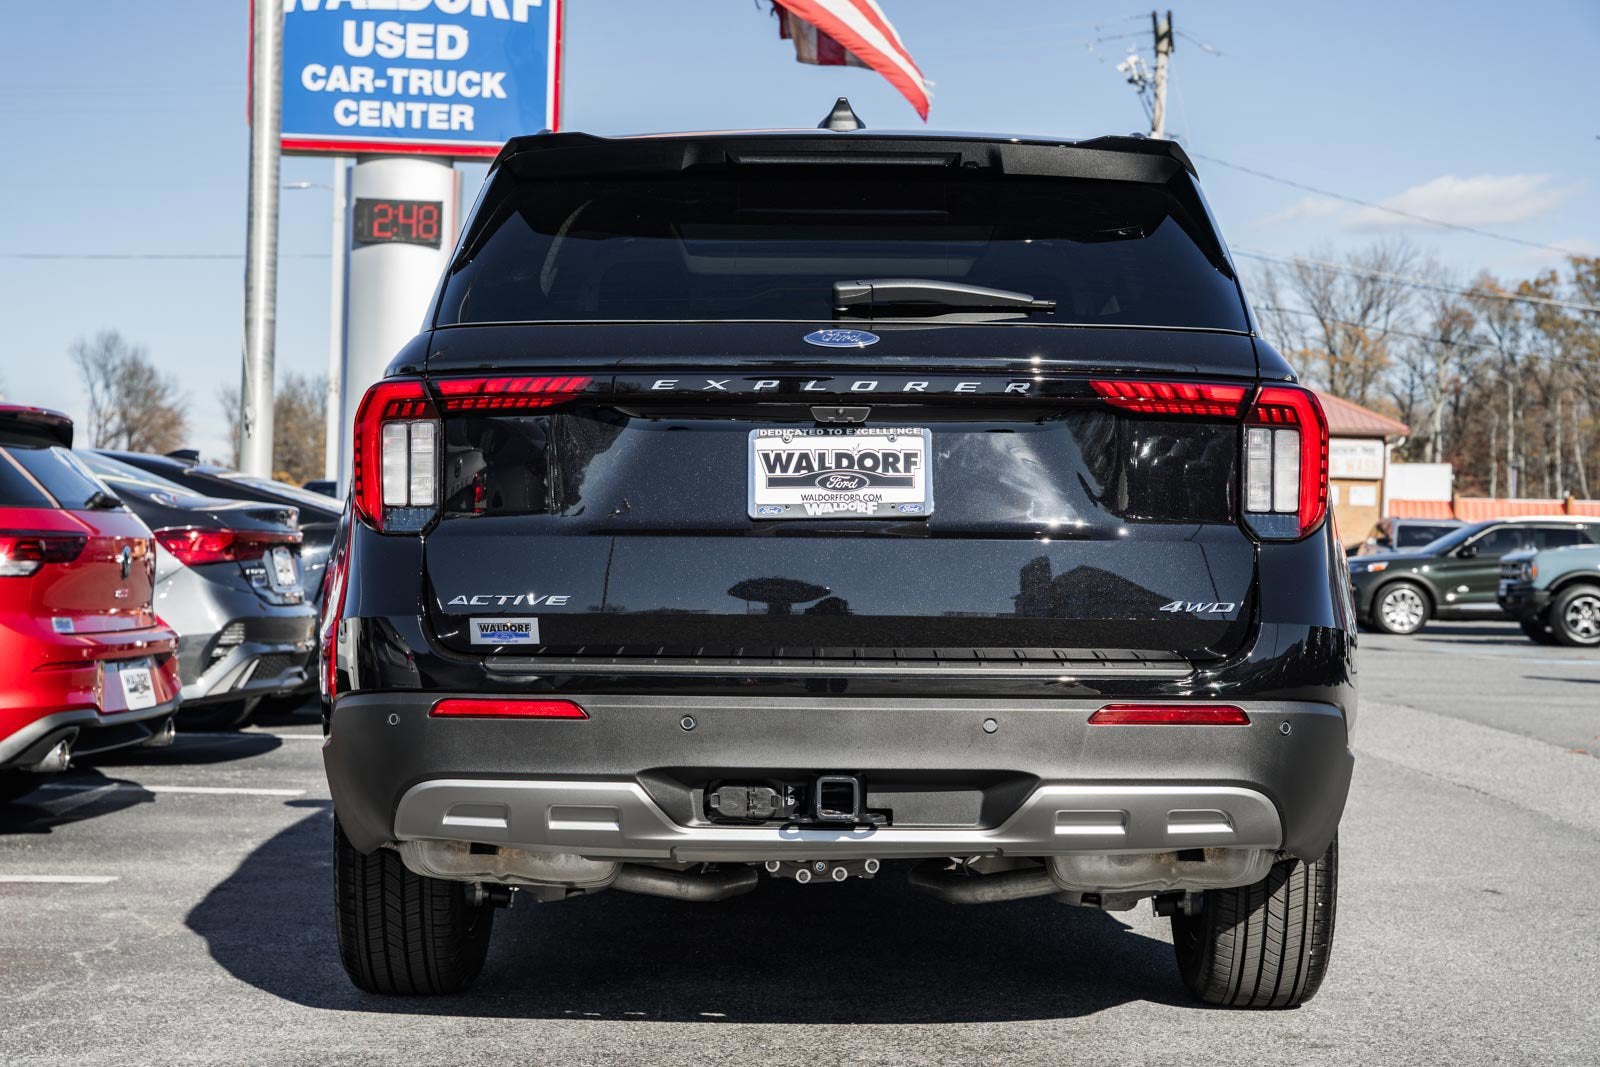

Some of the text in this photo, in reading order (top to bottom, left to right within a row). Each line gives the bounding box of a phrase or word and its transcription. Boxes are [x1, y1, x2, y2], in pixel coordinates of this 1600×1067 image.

[342, 20, 469, 61] USED
[301, 64, 507, 99] CAR-TRUCK
[333, 99, 474, 131] CENTER
[373, 203, 438, 239] 2:48
[651, 378, 1032, 393] EXPLORER
[760, 427, 921, 436] DEDICATED TO EXCELLENCE
[761, 452, 919, 474] WALDORF
[826, 475, 859, 489] Ford
[801, 493, 883, 502] WALDORFFORD.COM
[803, 501, 878, 516] WALDORF
[447, 594, 571, 606] ACTIVE
[1160, 600, 1235, 613] 4WD
[479, 624, 530, 633] WALDORF
